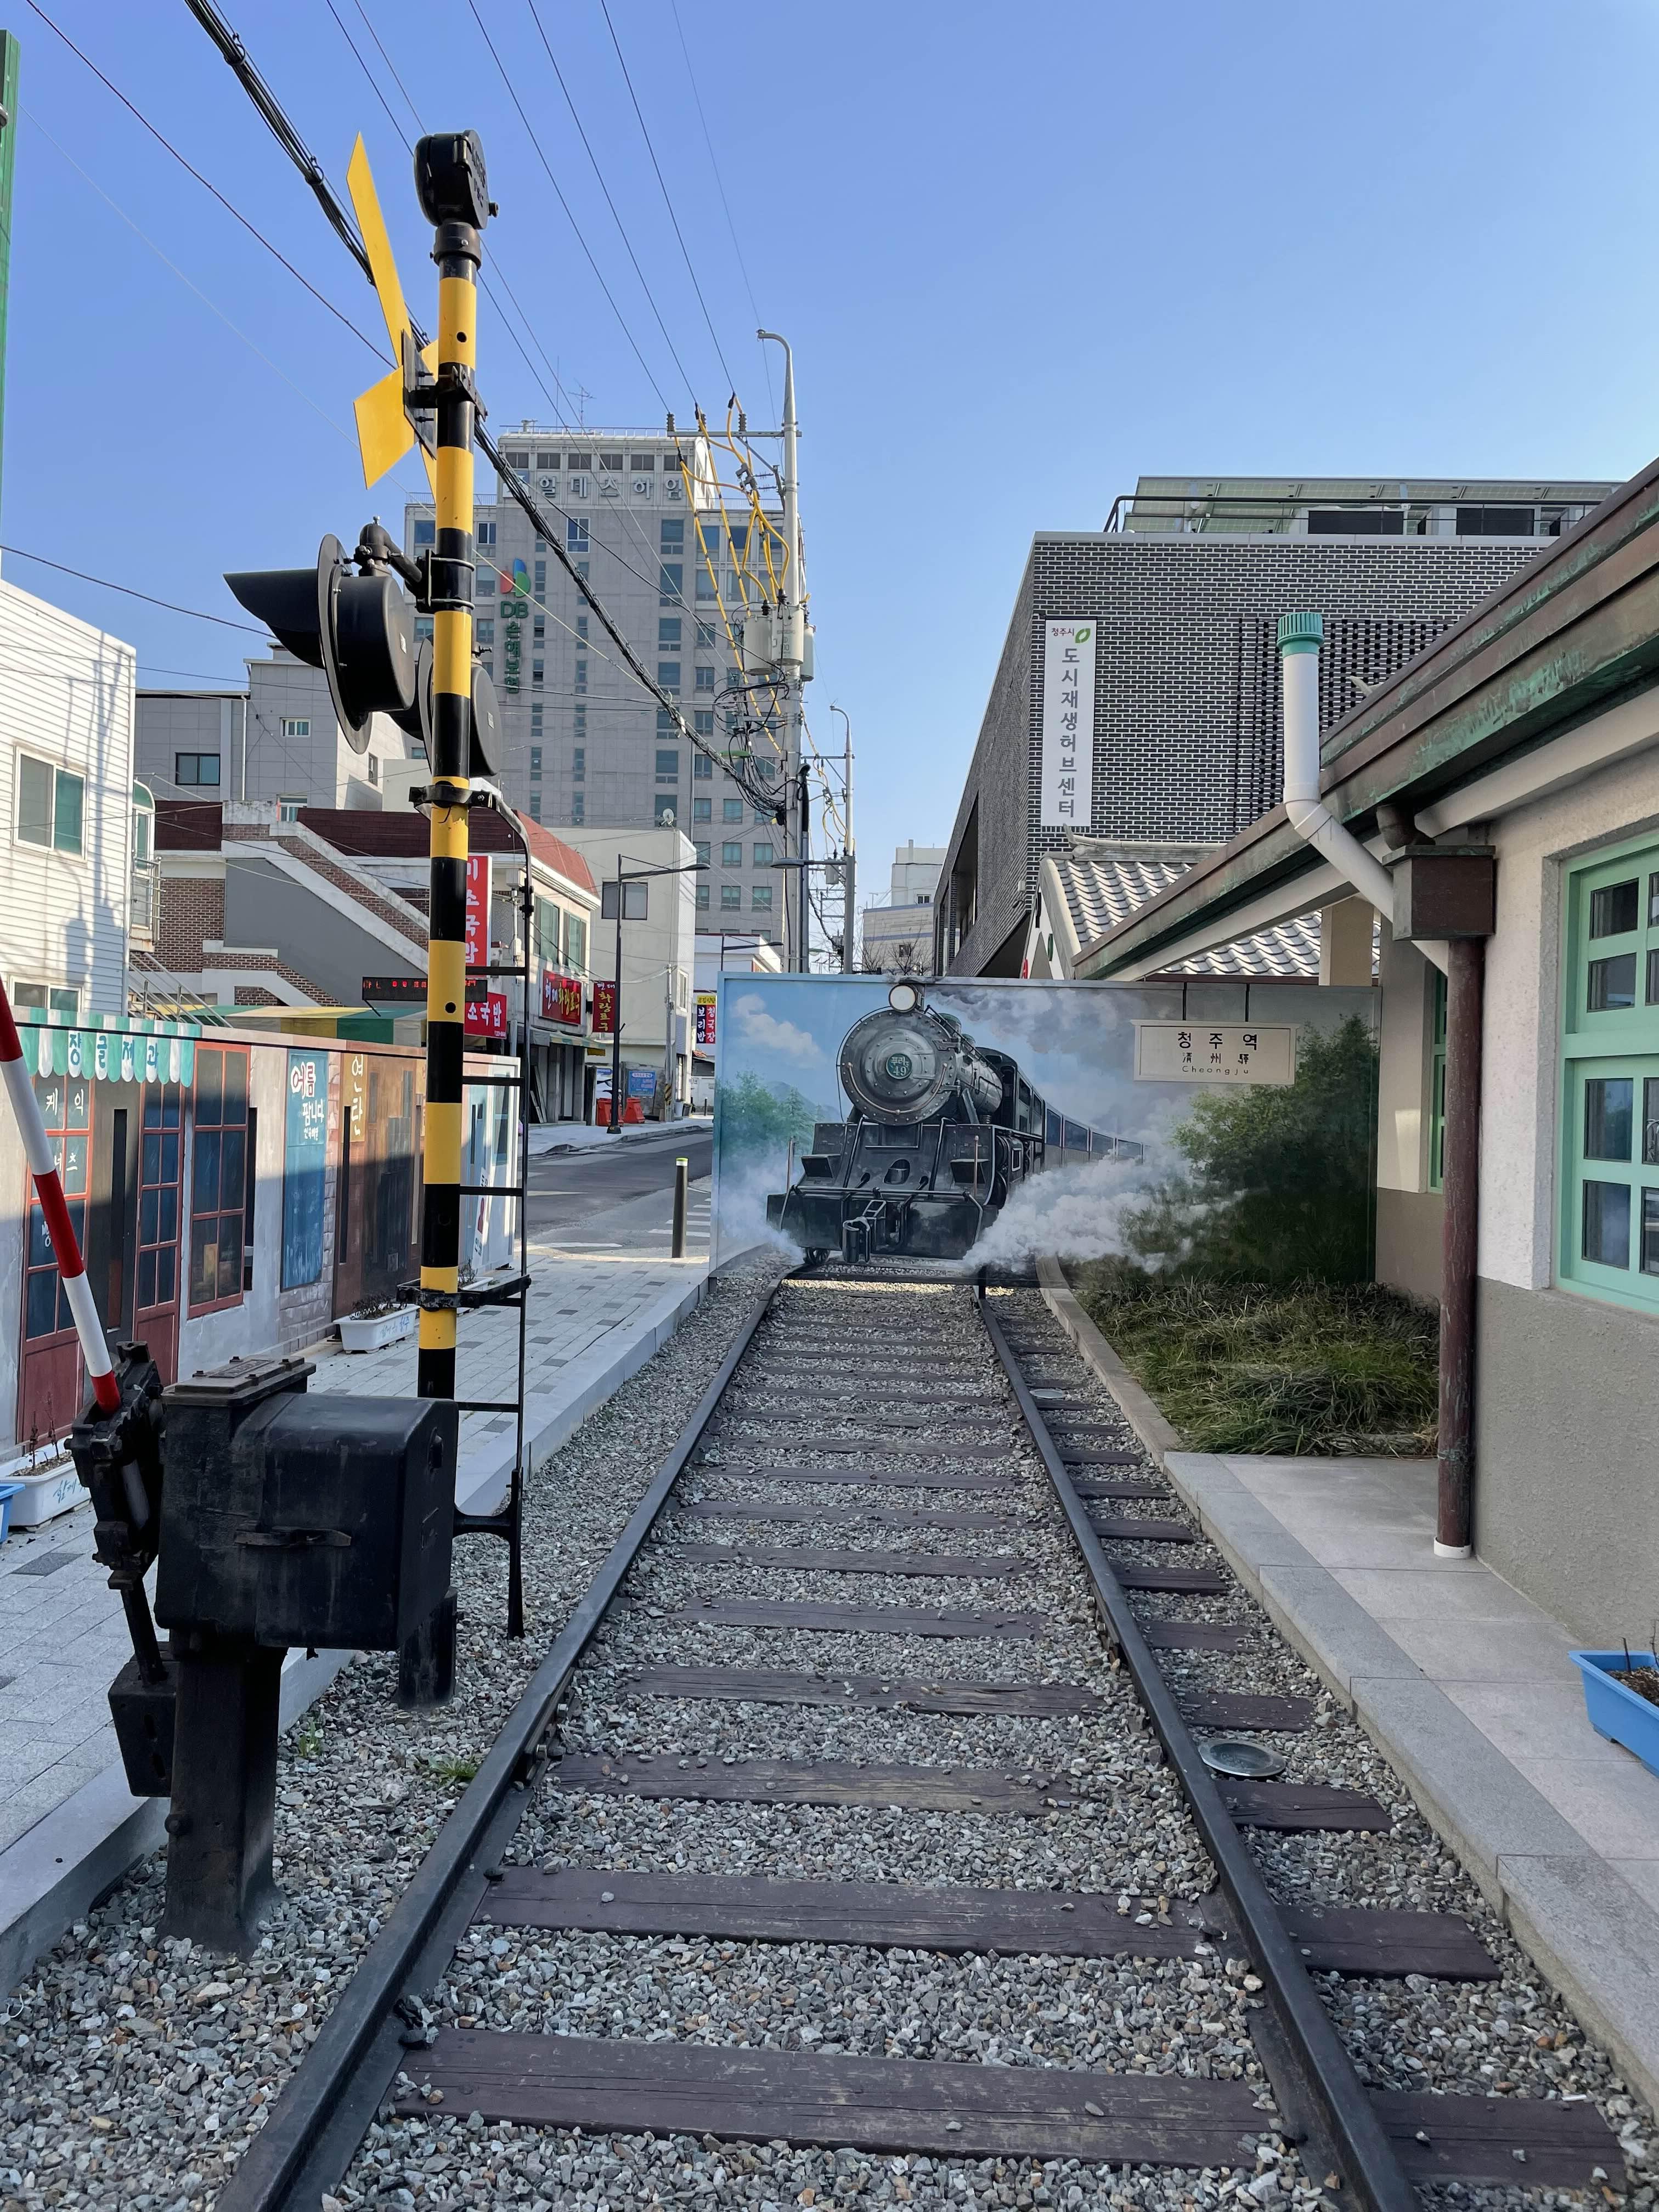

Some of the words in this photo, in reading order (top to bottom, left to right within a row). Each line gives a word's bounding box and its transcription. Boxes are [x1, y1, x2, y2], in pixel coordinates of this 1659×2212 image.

[539, 476, 683, 500] 힐데스하임
[500, 601, 528, 618] DB
[1052, 628, 1075, 636] 청주시
[504, 621, 521, 693] 손해보험
[1058, 648, 1080, 817] 도시재생허브센터
[468, 1001, 502, 1027] 소국밥
[598, 991, 613, 1031] 화랑표구
[697, 1007, 706, 1042] 보리밥
[707, 1007, 715, 1042] 청국장
[1178, 1031, 1257, 1050] 청주역
[291, 1062, 316, 1099] 어름
[1182, 1066, 1249, 1075] Cheongju
[46, 1088, 83, 1116] 케익
[352, 1054, 363, 1136] 연탄
[302, 1098, 324, 1126] 팝니다
[54, 1153, 77, 1171] 너츠
